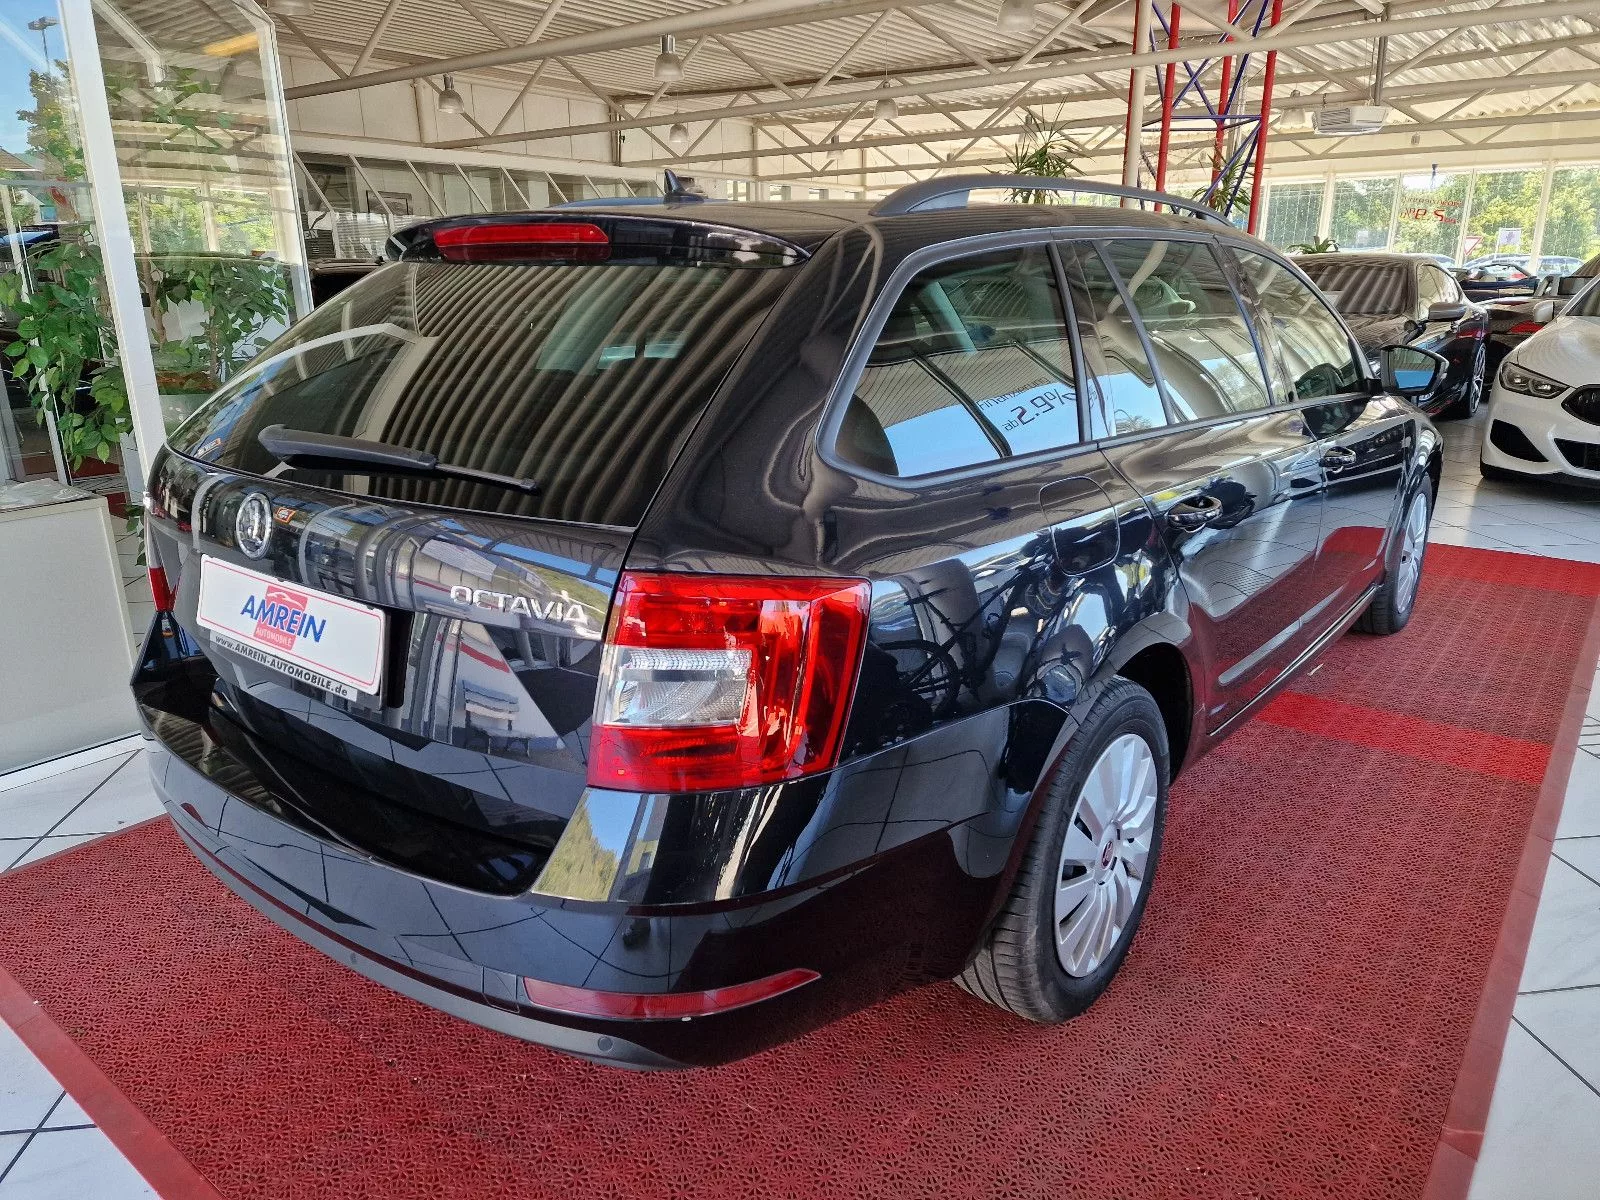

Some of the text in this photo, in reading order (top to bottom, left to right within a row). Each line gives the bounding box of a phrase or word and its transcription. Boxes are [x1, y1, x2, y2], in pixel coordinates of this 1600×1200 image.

[240, 595, 326, 643] AMREIN
[450, 585, 588, 625] OCTAVIA
[255, 626, 293, 647] AUTOMOBILE
[215, 636, 348, 697] www.AMREIN-AUTOMOBILE.de
